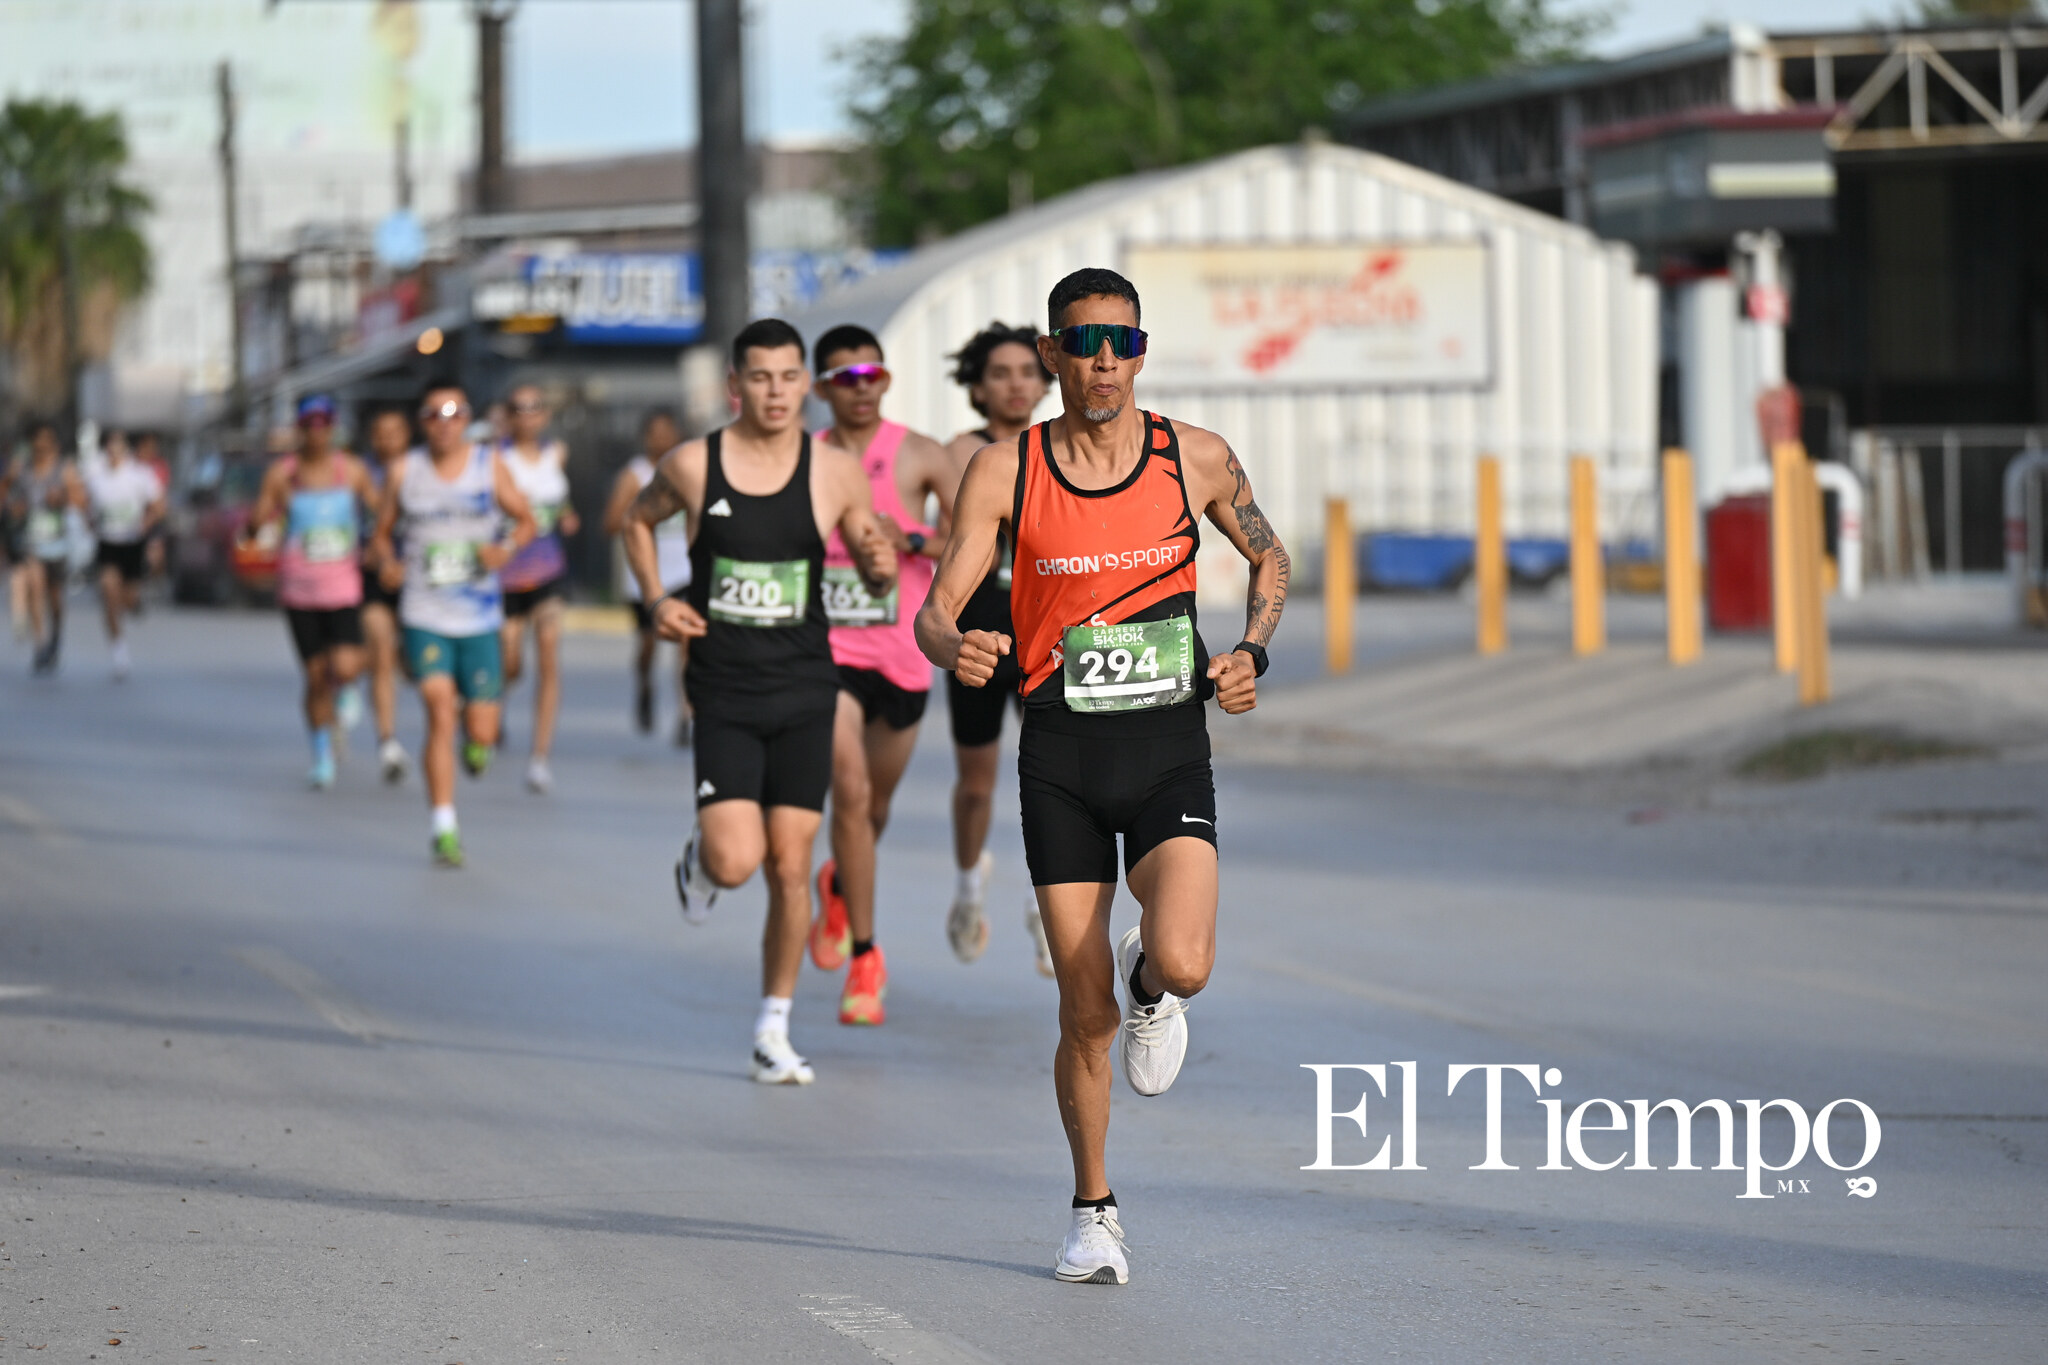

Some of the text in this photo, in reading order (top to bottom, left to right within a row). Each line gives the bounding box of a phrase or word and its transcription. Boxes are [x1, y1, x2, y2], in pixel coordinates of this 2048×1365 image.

[720, 577, 782, 606] 200
[1092, 626, 1144, 636] CARRERA
[1177, 621, 1190, 631] 294
[1079, 646, 1159, 684] 294
[1179, 635, 1191, 691] MEDALLA
